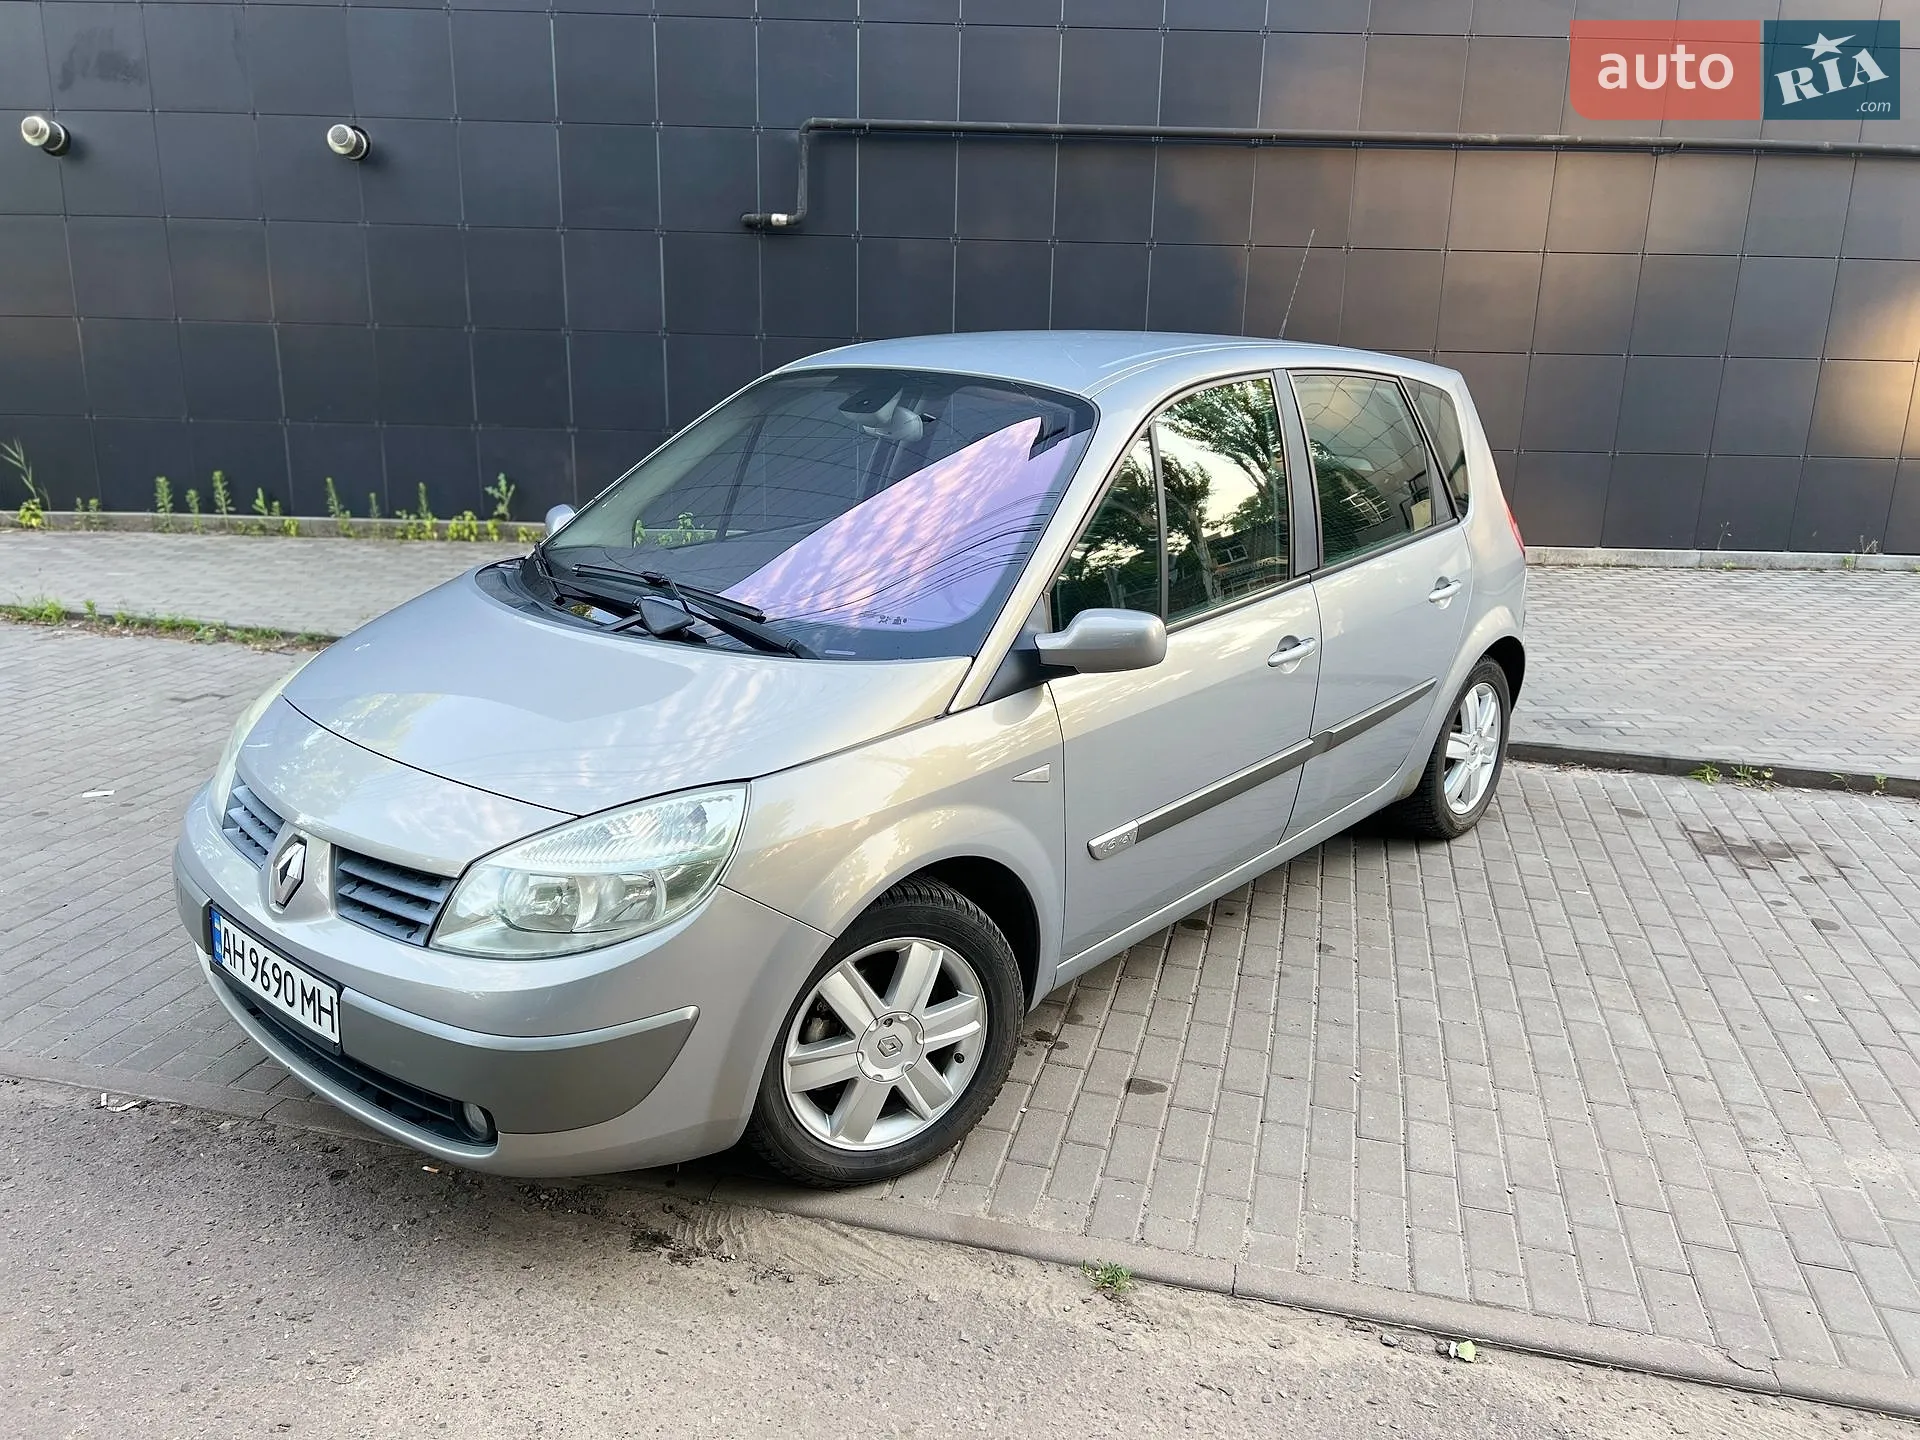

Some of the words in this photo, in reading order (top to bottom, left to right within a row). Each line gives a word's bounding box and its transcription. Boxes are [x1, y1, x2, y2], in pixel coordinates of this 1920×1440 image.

[222, 928, 246, 977] AH
[249, 947, 296, 1008] 9690
[300, 978, 336, 1034] MH
